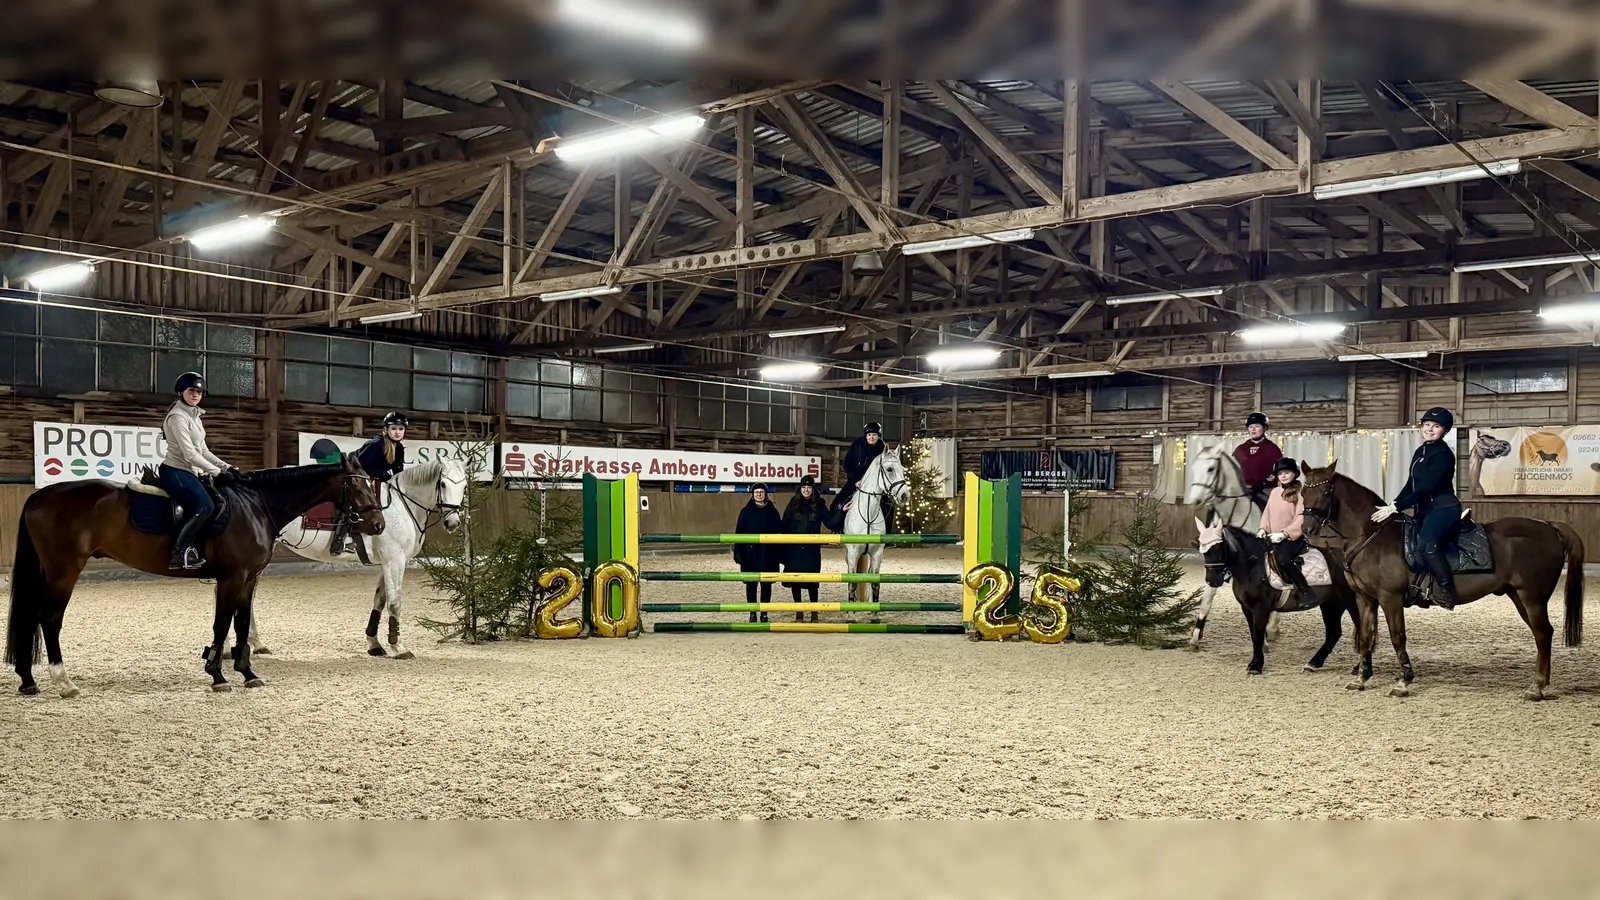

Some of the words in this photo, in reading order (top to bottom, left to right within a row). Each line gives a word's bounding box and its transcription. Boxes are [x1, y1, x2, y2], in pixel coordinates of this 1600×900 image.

[533, 453, 642, 475] Sparkasse
[648, 458, 717, 480] Amberg
[733, 461, 802, 478] Sulzbach
[1514, 472, 1573, 481] GUGGENMOS
